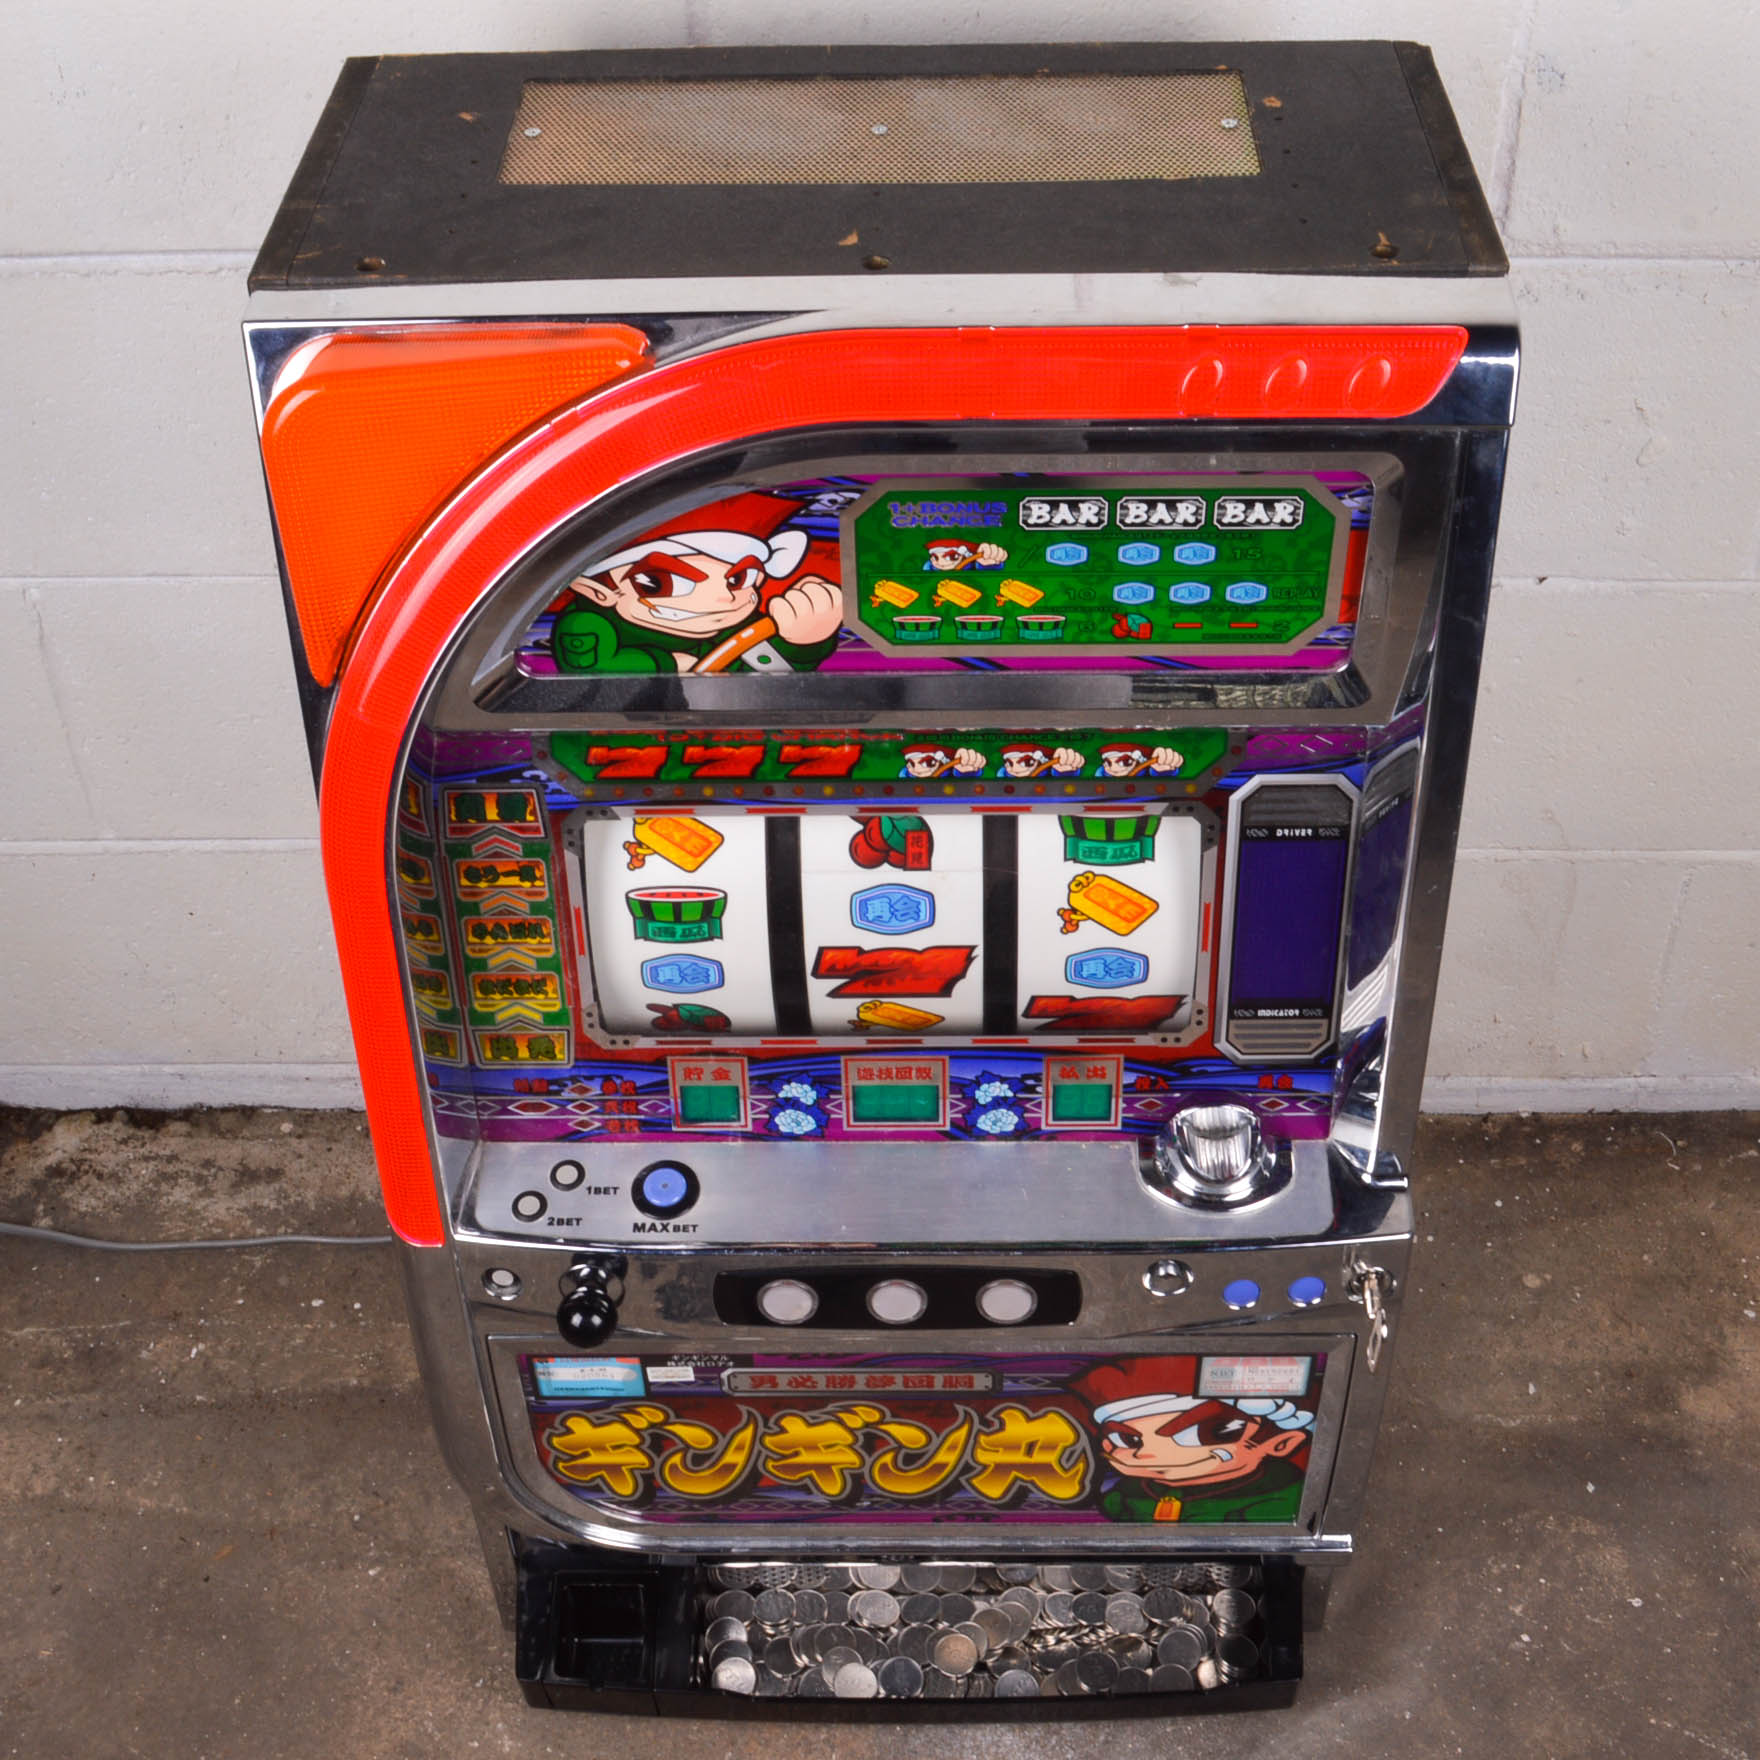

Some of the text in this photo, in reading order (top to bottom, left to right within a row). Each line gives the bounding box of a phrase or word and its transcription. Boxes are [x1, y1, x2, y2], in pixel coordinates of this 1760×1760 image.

[1029, 501, 1295, 525] BAR BAR BAR
[891, 514, 1003, 527] CHANCE
[1231, 547, 1262, 560] 15
[1271, 587, 1321, 600] REPLAY
[1275, 828, 1313, 837] DRIVER
[1257, 1008, 1300, 1017] INDICATOR
[586, 1186, 620, 1196] 1BET
[547, 1216, 583, 1227] 2BET
[633, 1222, 699, 1234] MAX BET
[546, 1402, 1091, 1500] ギンギン丸
